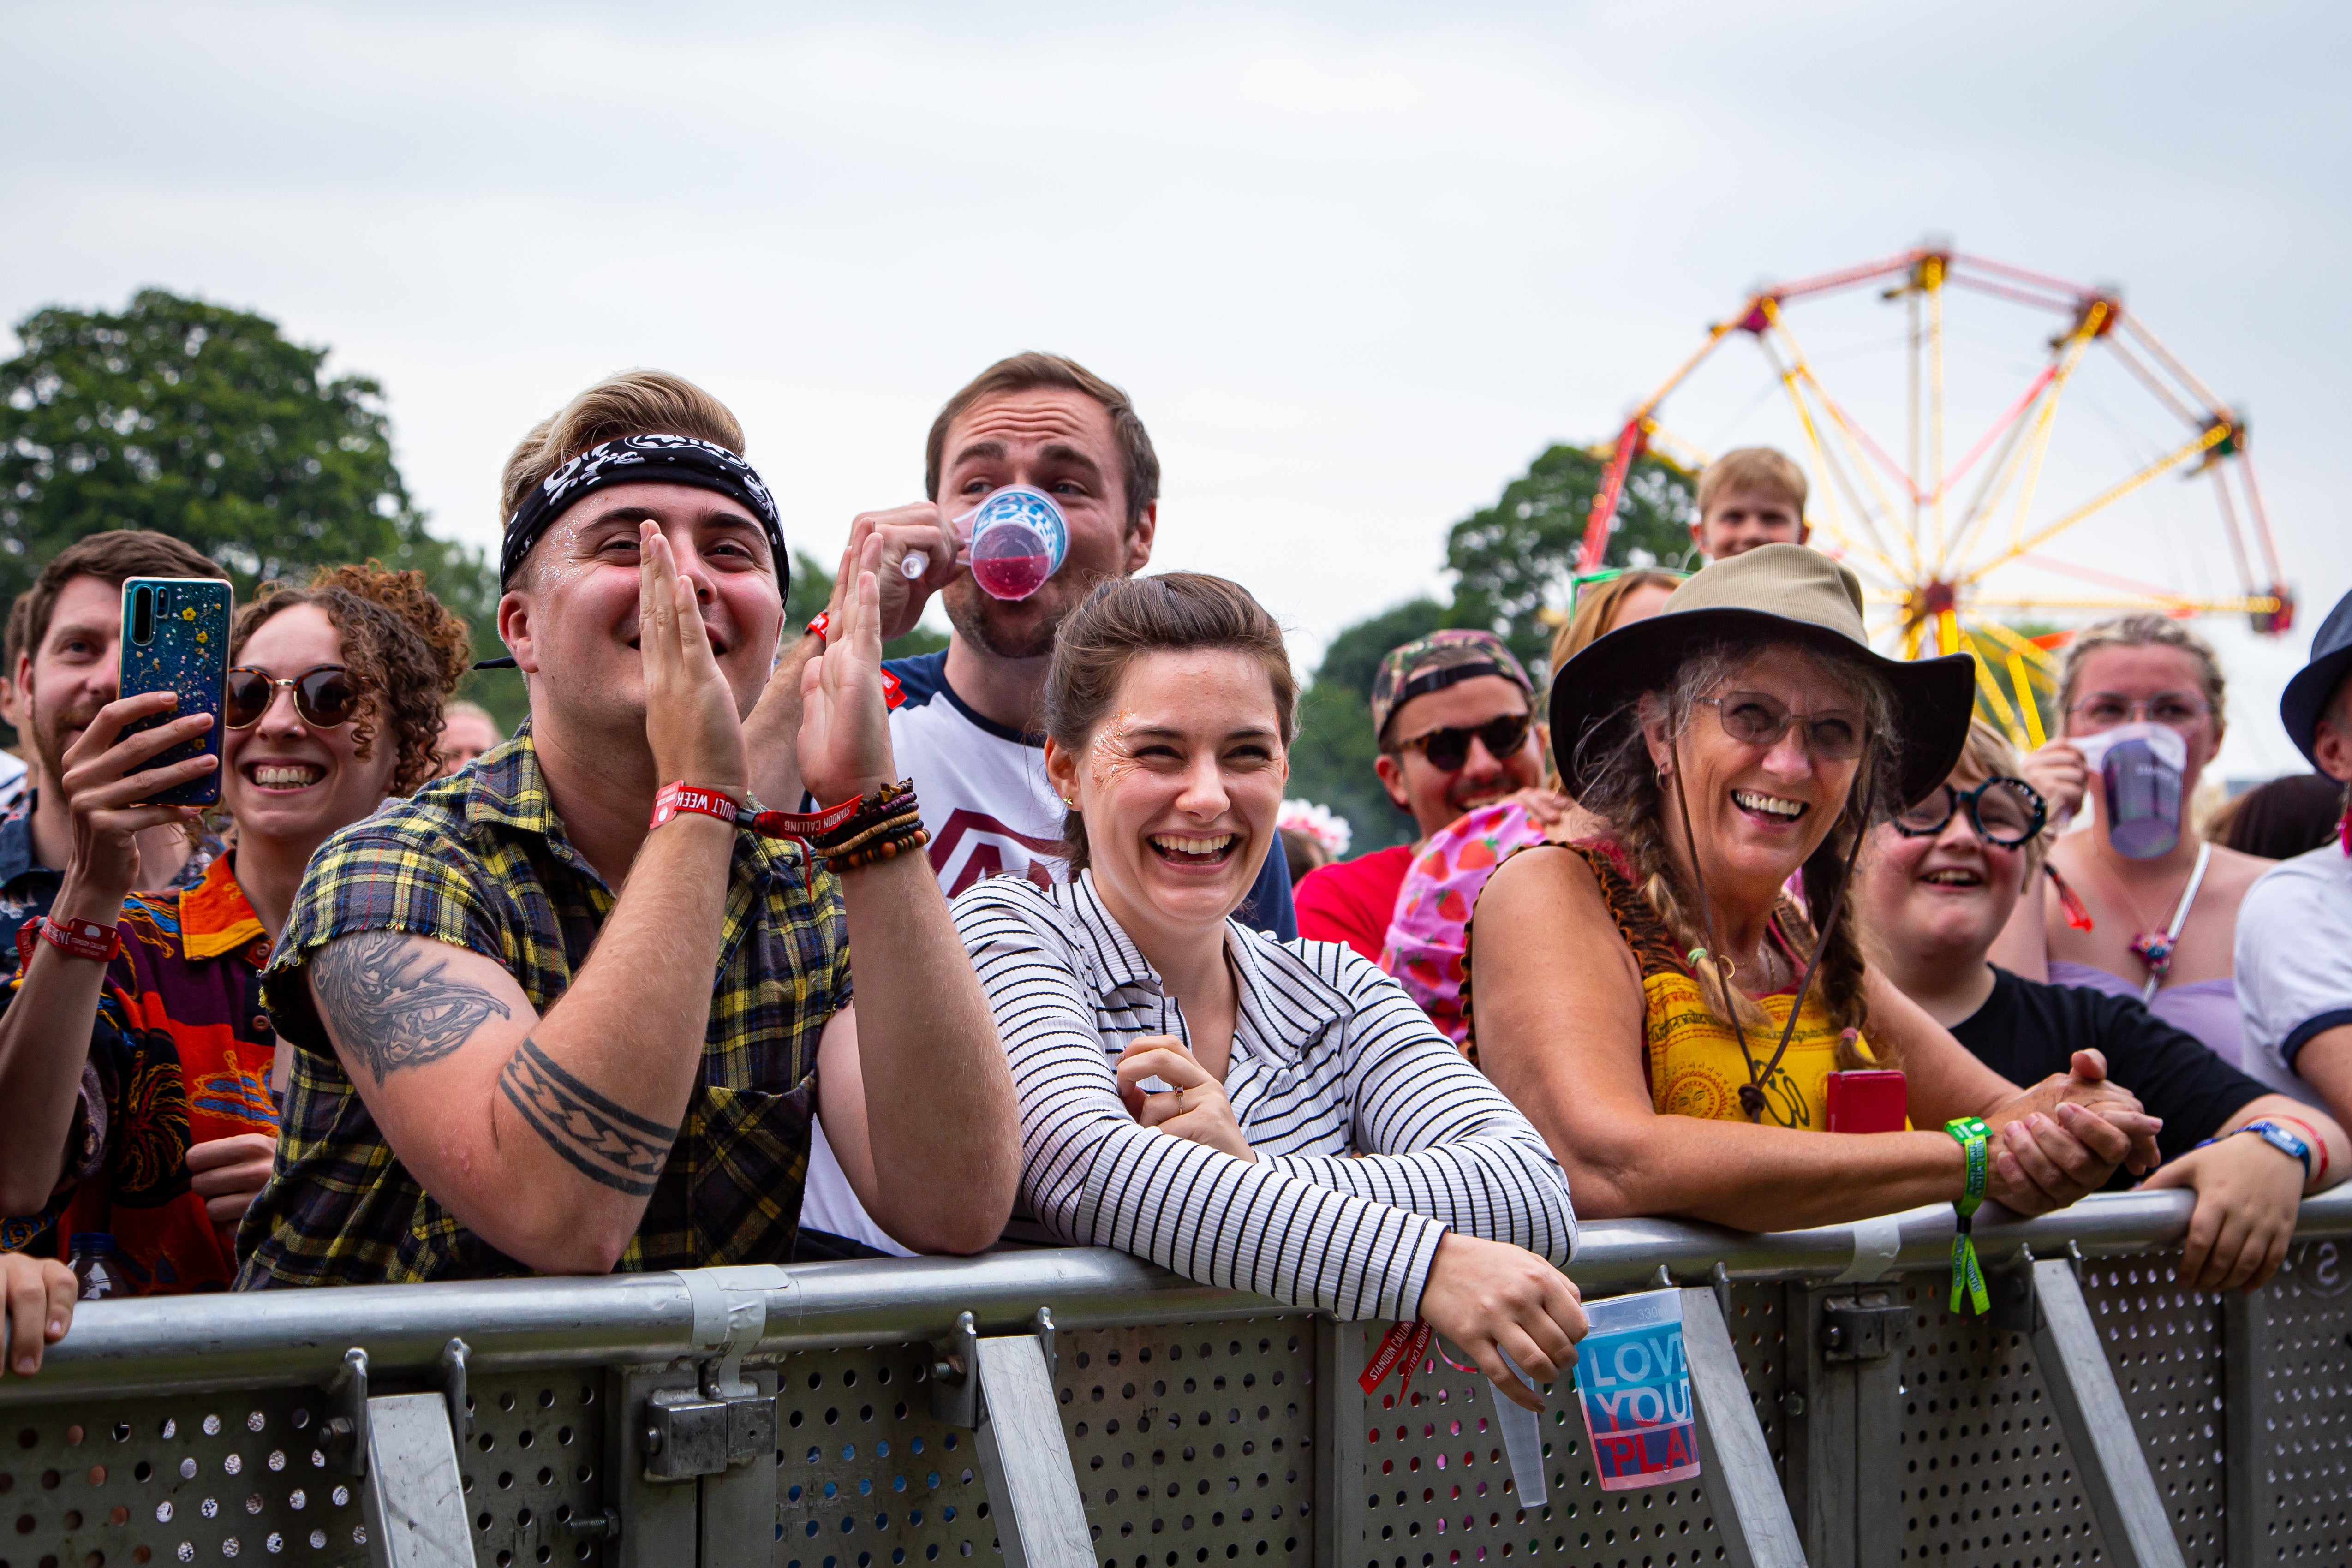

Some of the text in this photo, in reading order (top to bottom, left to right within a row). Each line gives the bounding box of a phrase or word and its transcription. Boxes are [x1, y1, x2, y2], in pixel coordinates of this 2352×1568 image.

[675, 792, 708, 810] WEEK
[785, 805, 851, 832] STANDON CALLING
[1369, 1345, 1397, 1381] STANDON
